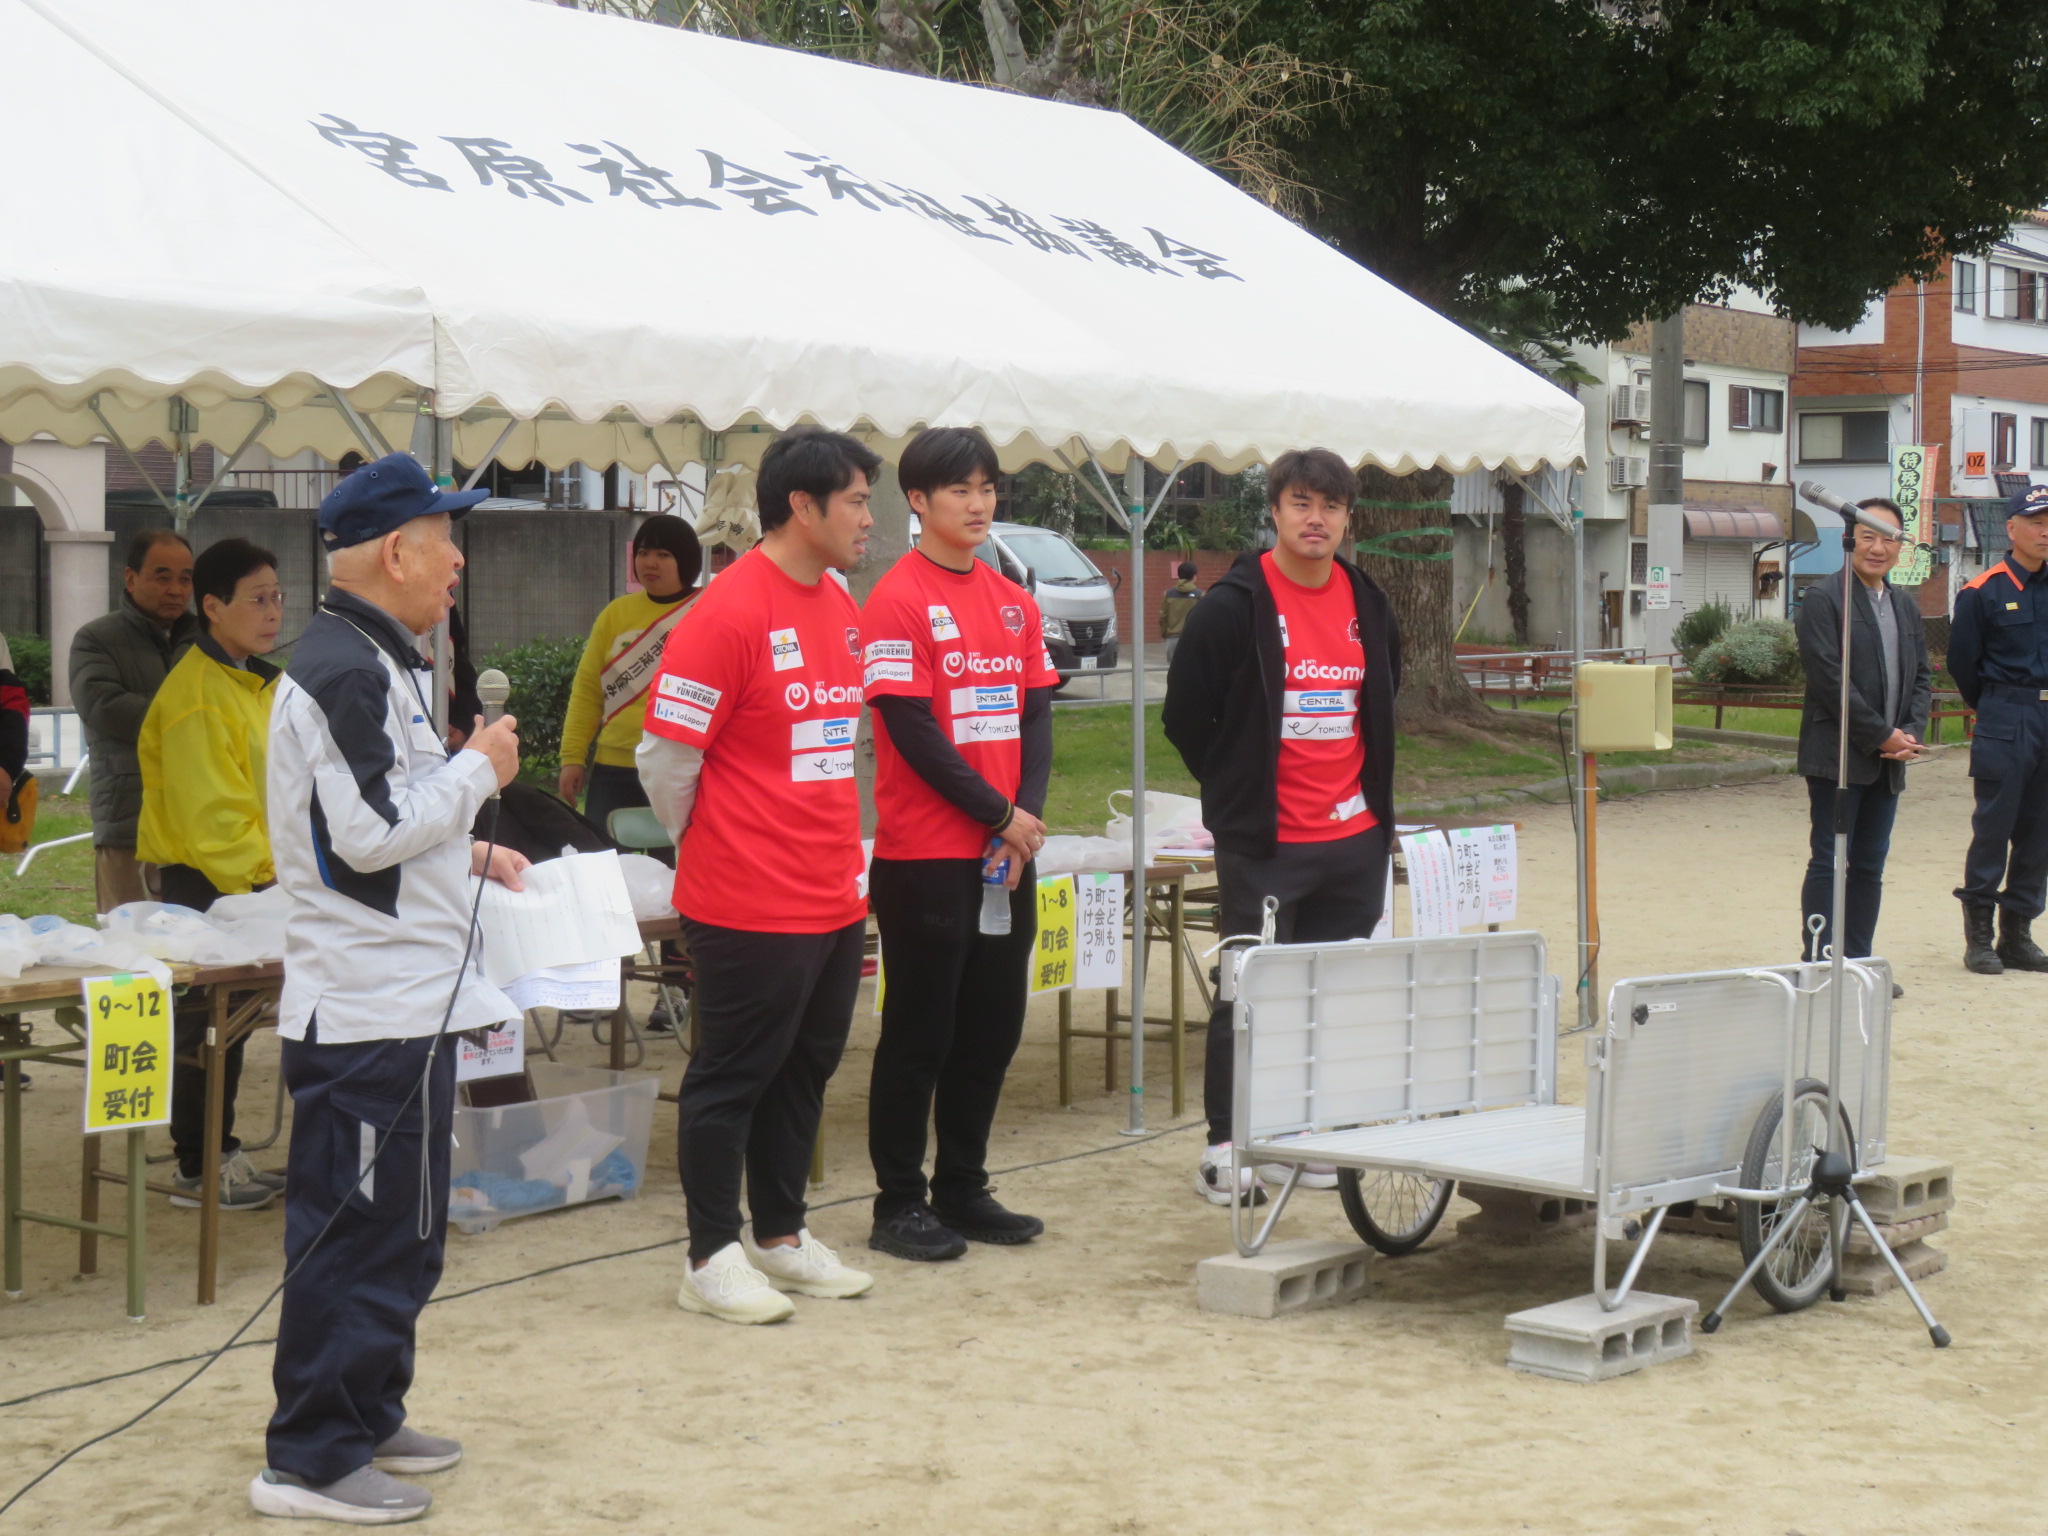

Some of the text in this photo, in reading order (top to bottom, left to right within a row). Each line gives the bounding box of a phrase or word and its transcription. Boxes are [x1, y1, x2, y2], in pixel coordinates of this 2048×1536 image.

[1967, 455, 1985, 467] OZ
[871, 648, 910, 657] YUNIBEHRU
[877, 668, 910, 677] LaLaport
[676, 686, 717, 707] YUNIBEHRU
[976, 693, 1014, 703] ENTRAL
[677, 711, 707, 728] LaLaport
[1457, 843, 1466, 912] うけつけ
[1463, 843, 1473, 895] 町会別
[1083, 887, 1094, 967] うけつけ
[1094, 887, 1107, 947] 町会別
[1105, 888, 1117, 965] こどもの
[1041, 925, 1069, 953] 町会
[1040, 959, 1067, 987] 受付
[104, 1040, 158, 1076] 町会
[103, 1085, 154, 1121] 受付
